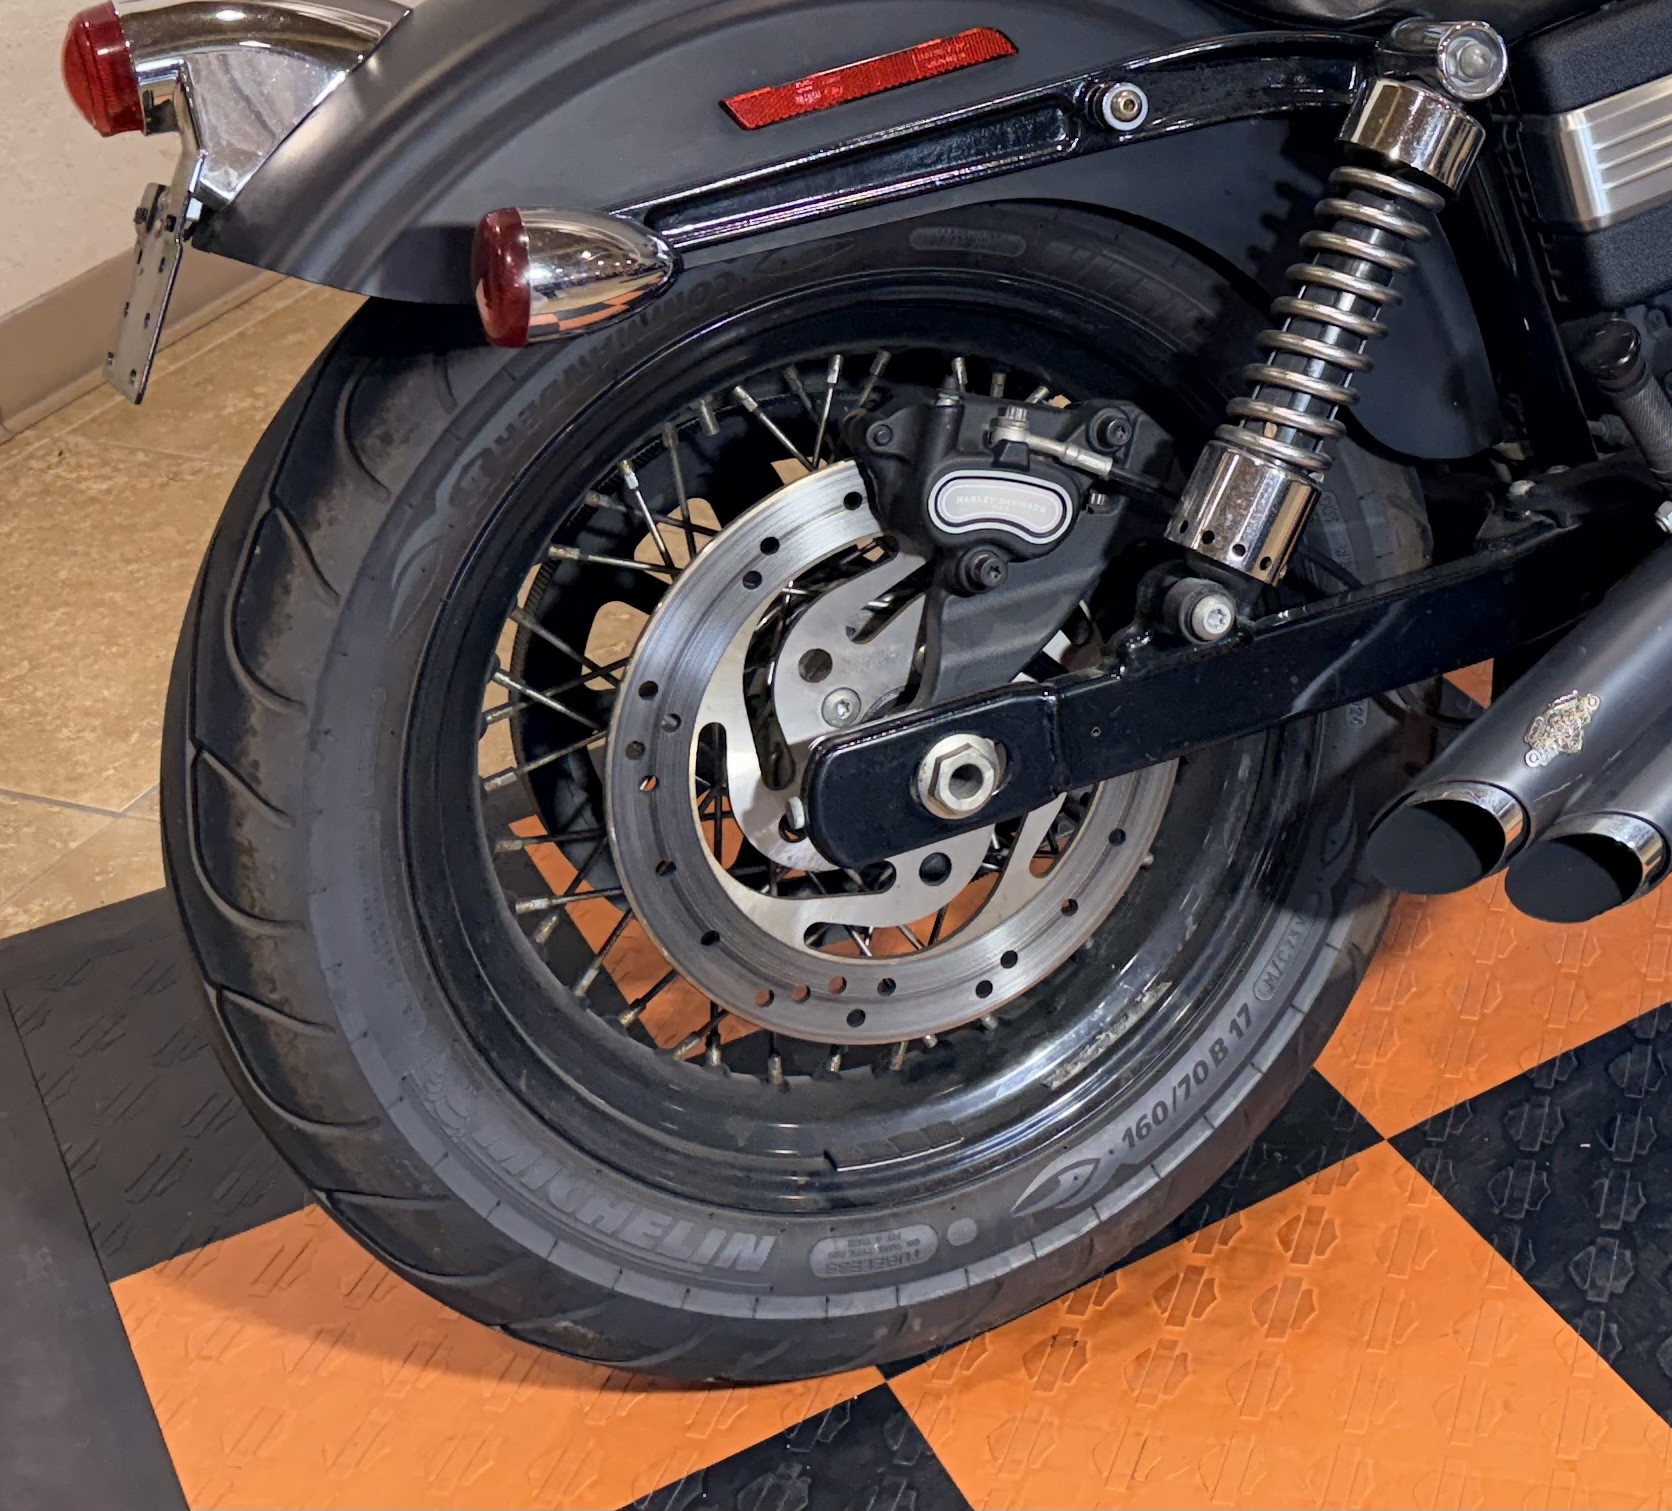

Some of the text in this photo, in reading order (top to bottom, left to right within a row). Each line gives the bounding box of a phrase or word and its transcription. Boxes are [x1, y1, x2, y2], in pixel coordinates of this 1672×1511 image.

[1122, 1002, 1252, 1148] 160/70 B 17
[471, 1125, 778, 1272] MICHELIN
